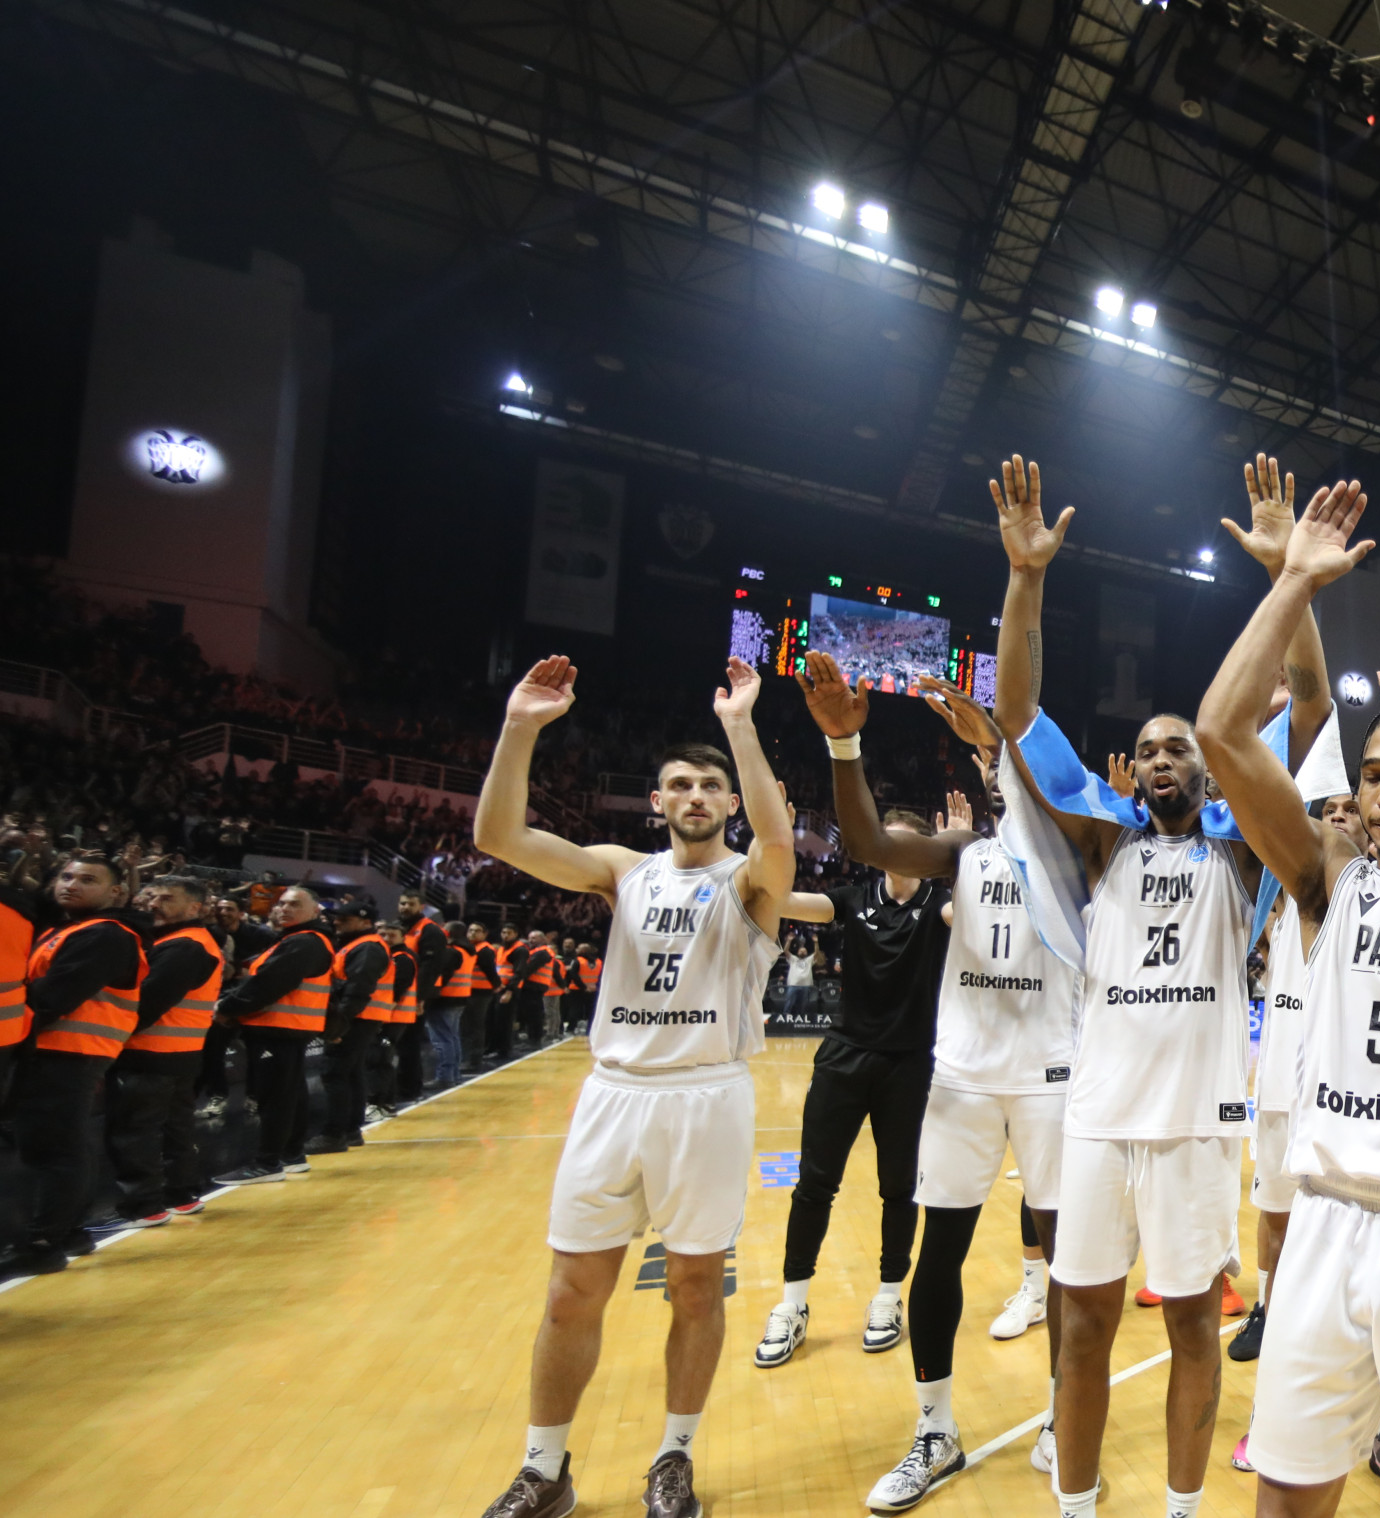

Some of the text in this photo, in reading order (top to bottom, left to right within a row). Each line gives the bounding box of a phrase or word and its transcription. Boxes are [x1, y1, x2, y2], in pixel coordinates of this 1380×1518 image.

[741, 567, 765, 581] PBC
[1141, 872, 1194, 903] PAOK
[642, 906, 699, 933] PAOK
[990, 923, 1011, 960] 11
[1143, 923, 1180, 967] 26
[644, 953, 684, 992] 25
[1107, 984, 1216, 1006] Stoiximan
[611, 1006, 717, 1025] Stoiximan
[775, 1014, 811, 1023] ARAL
